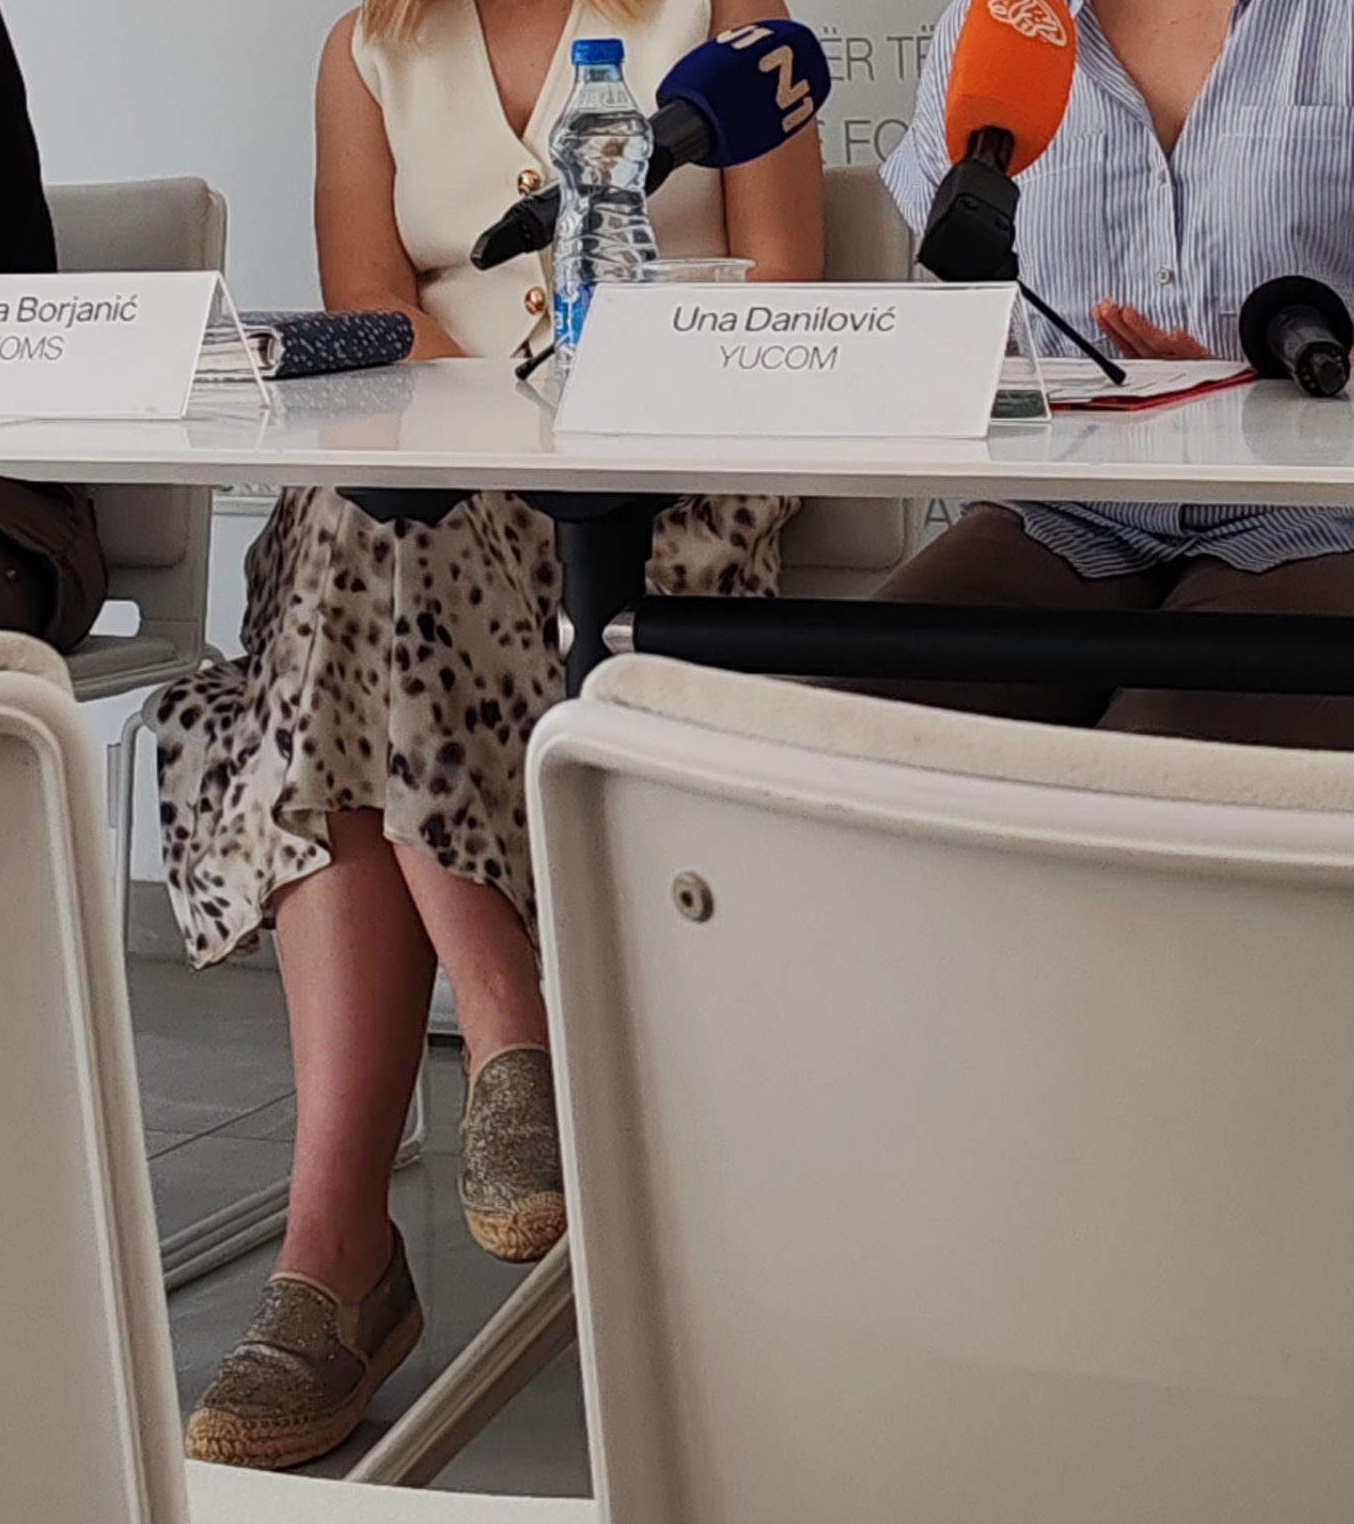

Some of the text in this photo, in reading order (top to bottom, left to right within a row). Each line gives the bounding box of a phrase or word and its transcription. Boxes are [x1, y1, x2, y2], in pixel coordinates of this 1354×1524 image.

[820, 27, 875, 81] ËR
[845, 119, 909, 165] FO
[17, 294, 139, 329] Borjanić
[673, 305, 897, 332] Una Danilović
[719, 344, 839, 370] YUCOM
